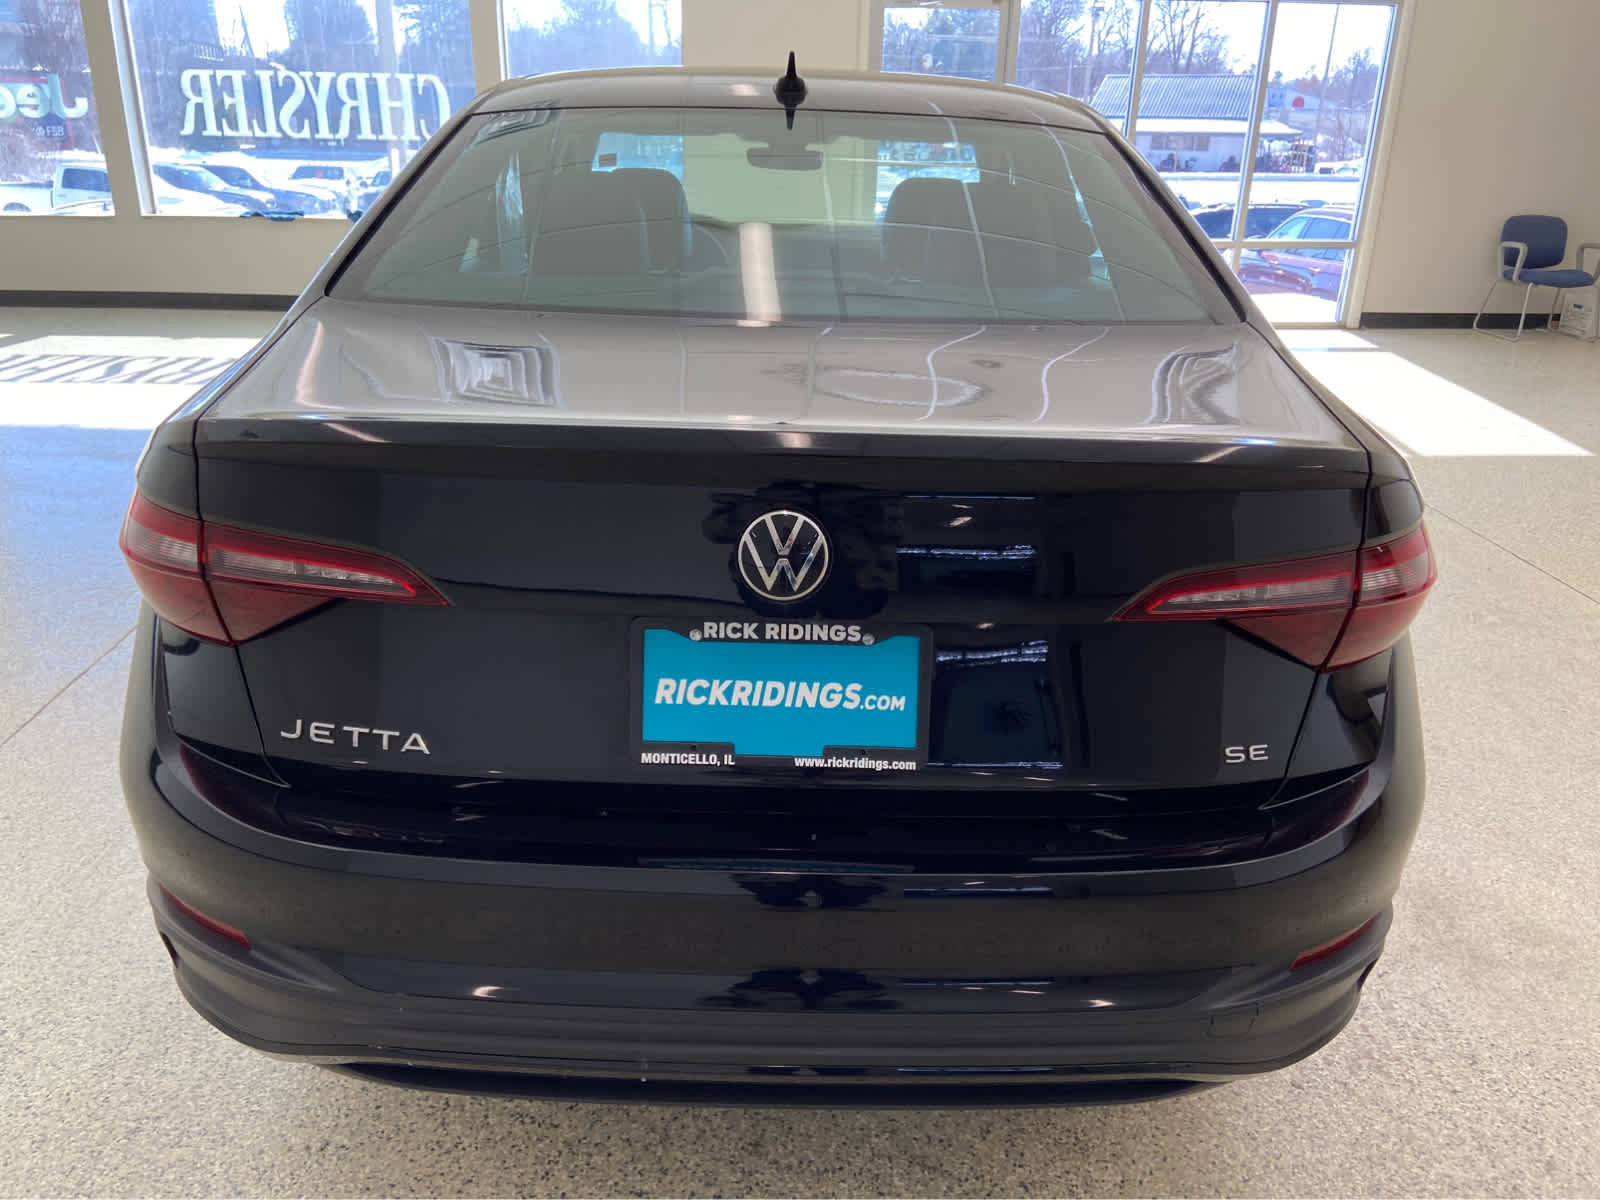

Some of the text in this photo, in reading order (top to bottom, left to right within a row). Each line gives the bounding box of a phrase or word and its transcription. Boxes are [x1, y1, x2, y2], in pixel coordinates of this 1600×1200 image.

[703, 621, 861, 642] RICK RIDINGS
[654, 677, 906, 711] RICKRIDINGS.COM
[280, 719, 431, 755] JETTA
[640, 753, 736, 766] MONTICELLO, IL
[794, 756, 917, 771] www.rickridings.com
[1224, 744, 1269, 763] SE
